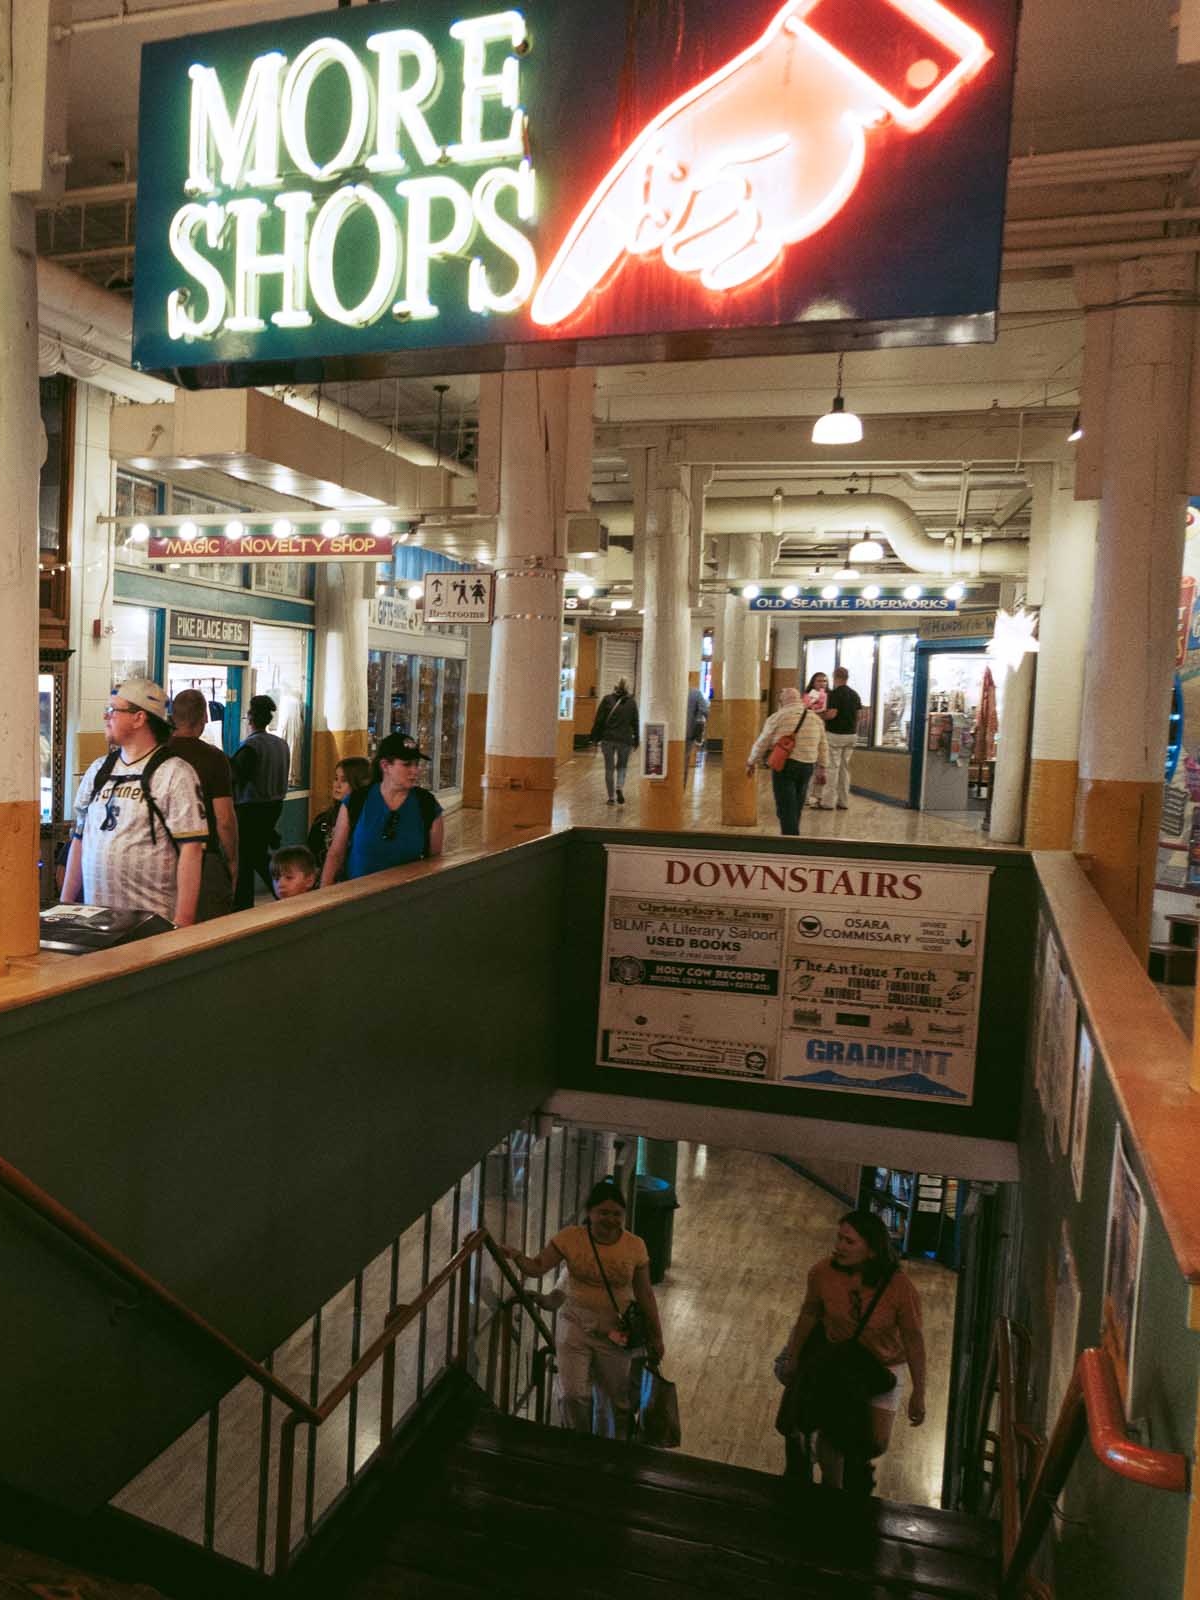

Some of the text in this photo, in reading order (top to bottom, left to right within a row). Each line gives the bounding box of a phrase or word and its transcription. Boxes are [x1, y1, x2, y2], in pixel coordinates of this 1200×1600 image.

[184, 9, 531, 196] MORE
[167, 160, 537, 342] SHOPS
[166, 539, 220, 554] MAGIC
[240, 537, 323, 554] NOVELTY
[330, 538, 376, 554] SHOP
[756, 598, 949, 609] OLD SEATTLE PAPERWORKS
[176, 616, 243, 641] PIKE PLACE GIFTS
[664, 859, 923, 901] DOWNSTAIRS
[658, 922, 670, 933] A
[672, 923, 725, 941] Literary
[728, 927, 778, 942] Saloon
[844, 918, 890, 930] OSARA
[646, 936, 742, 952] USED BOOKS
[823, 928, 912, 944] COMMISSARY
[655, 965, 766, 982] HOLY COW RECORDS
[793, 958, 937, 982] The Antique Touch
[806, 1039, 953, 1076] GRADIENT
